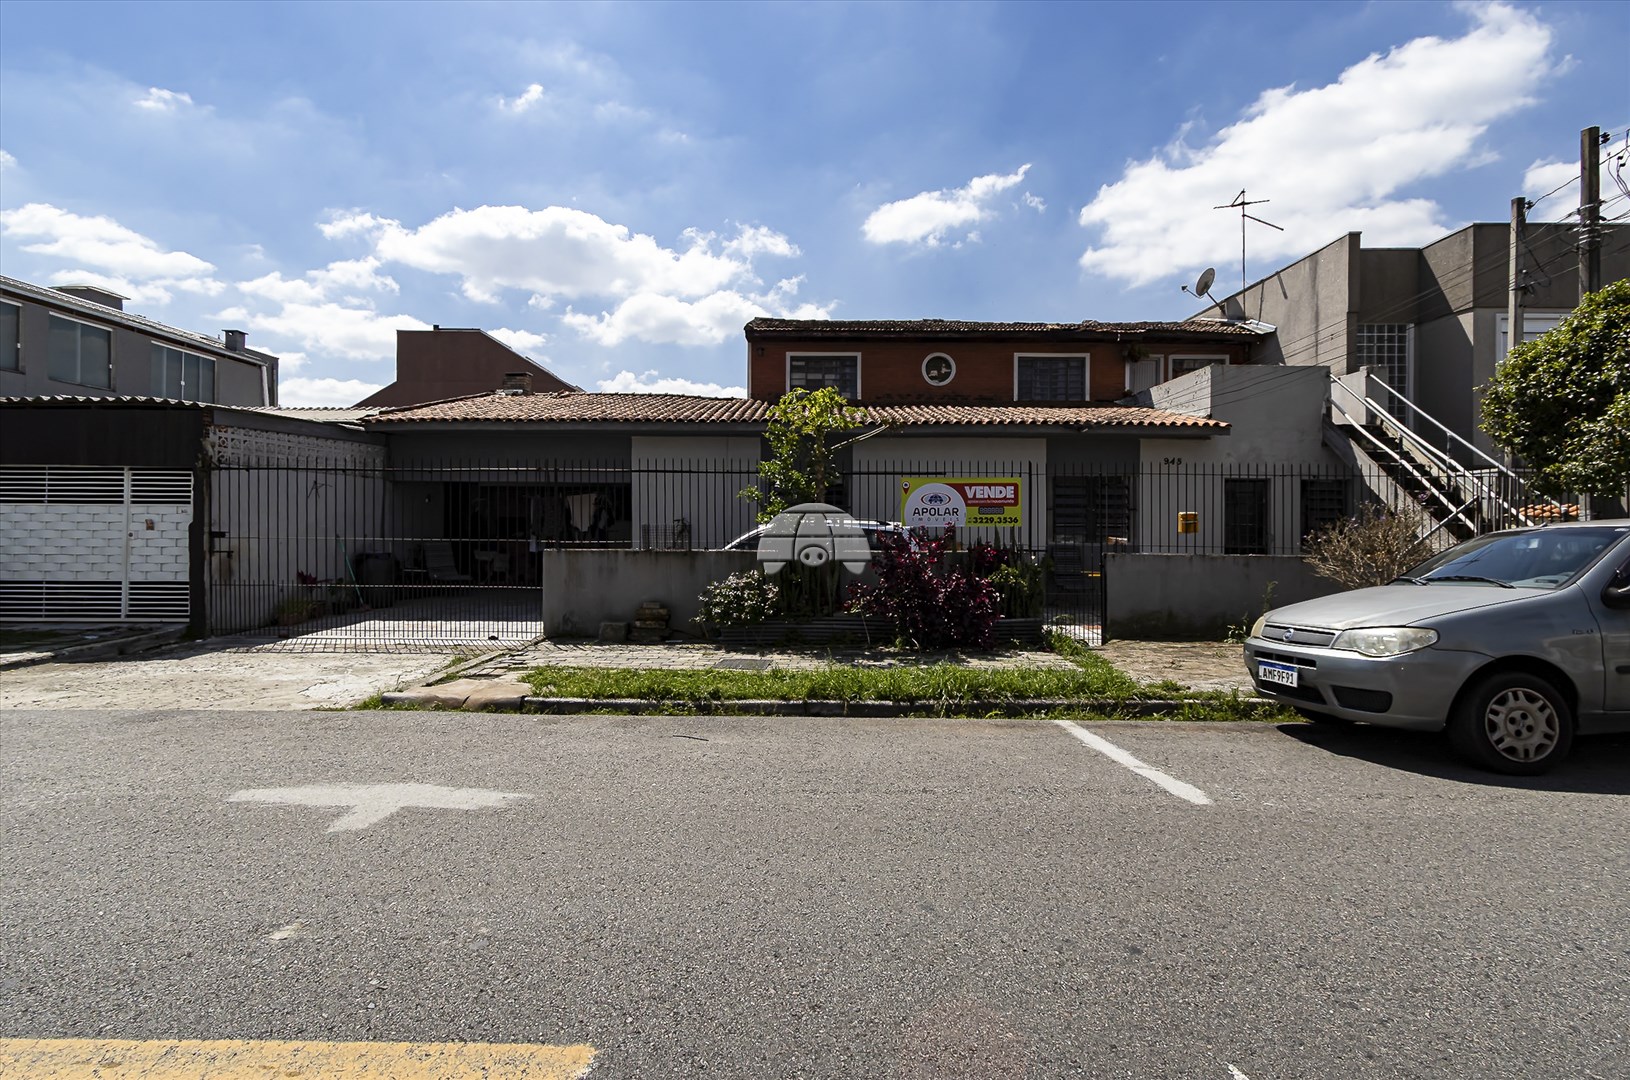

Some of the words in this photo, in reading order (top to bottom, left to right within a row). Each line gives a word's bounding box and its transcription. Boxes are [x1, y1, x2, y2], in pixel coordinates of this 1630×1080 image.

[964, 486, 1015, 498] VENDE
[912, 507, 959, 516] APOLAR
[973, 516, 1019, 524] 3229.3536
